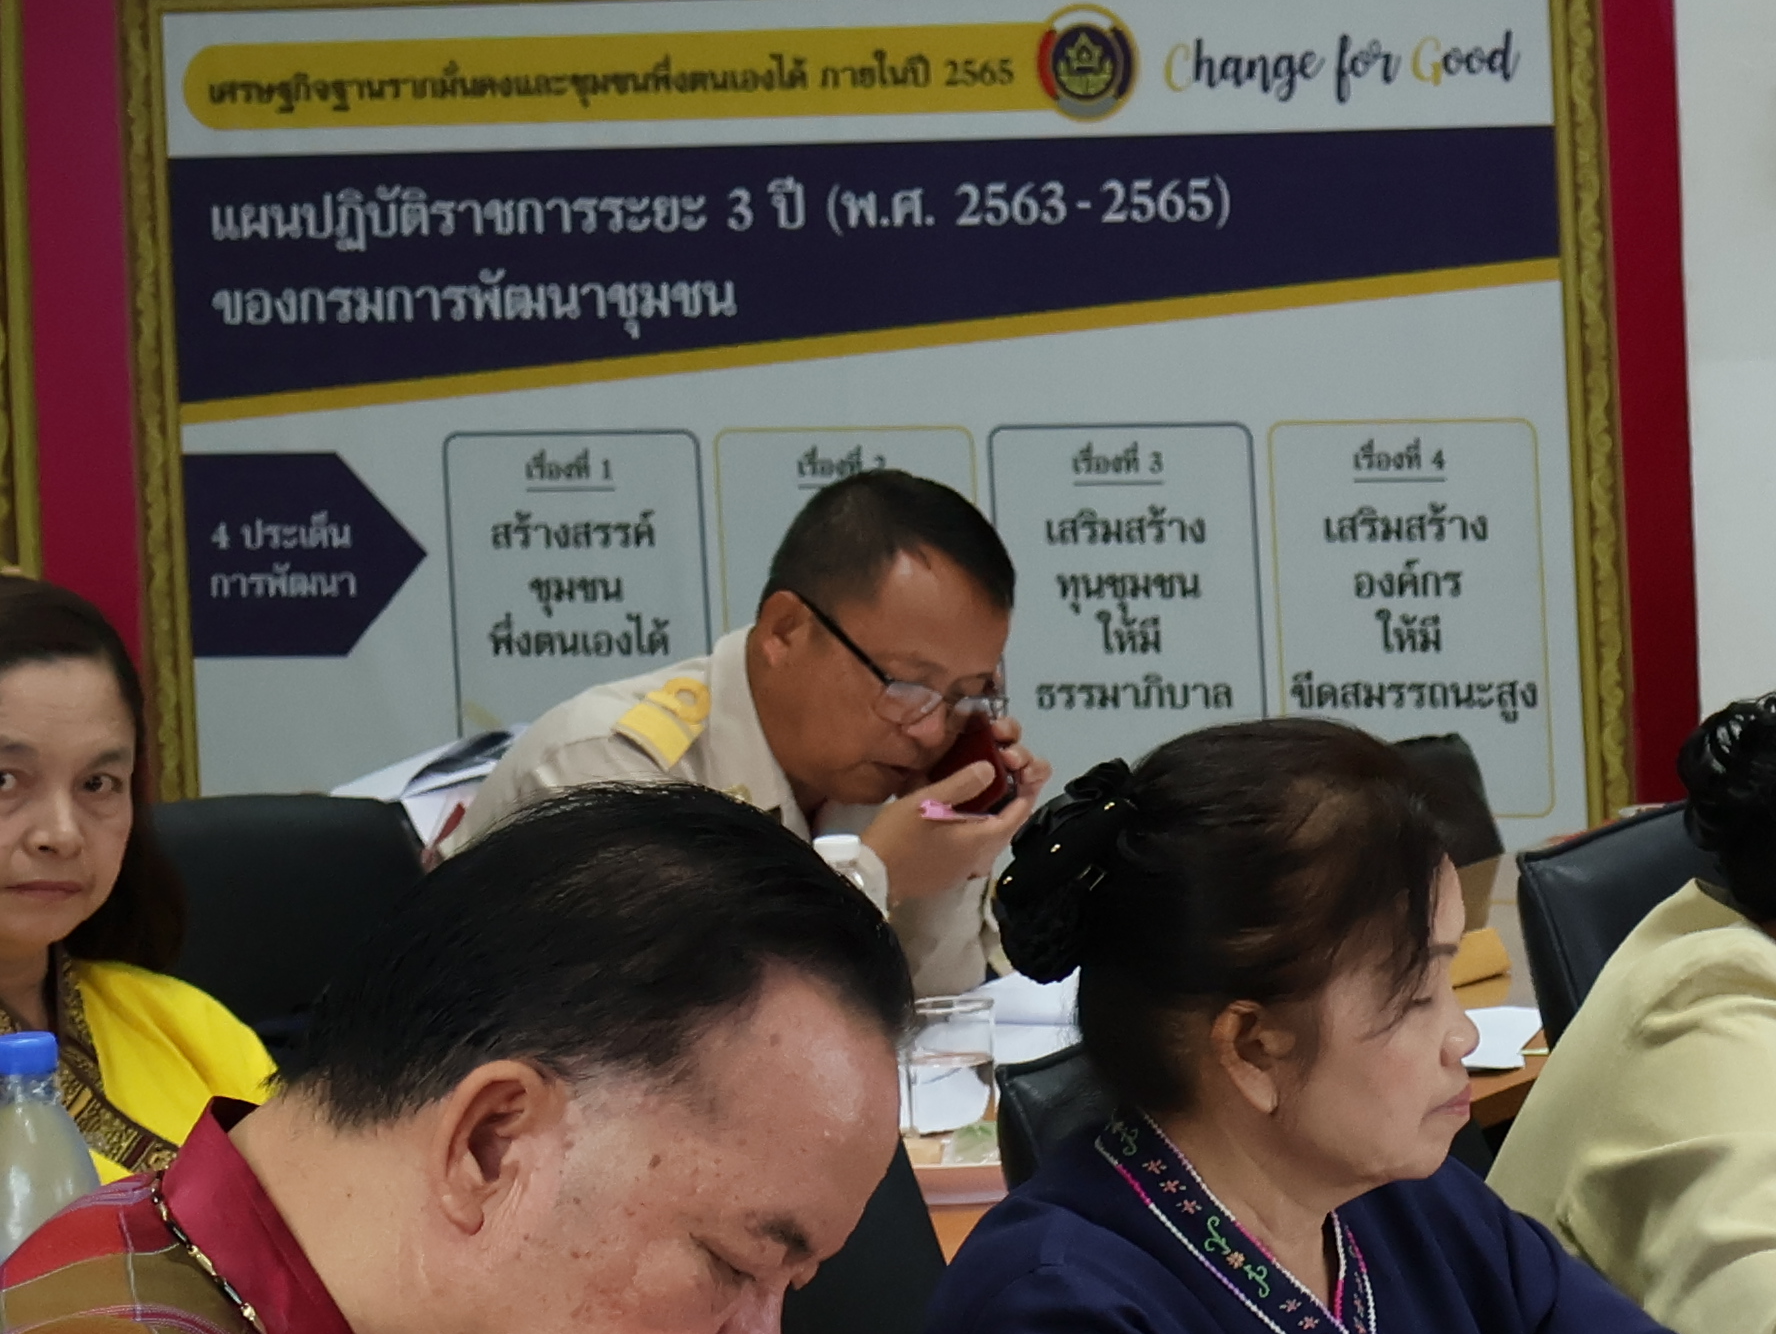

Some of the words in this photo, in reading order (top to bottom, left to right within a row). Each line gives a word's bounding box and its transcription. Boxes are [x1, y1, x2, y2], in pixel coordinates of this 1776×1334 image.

[945, 57, 1015, 88] 2565
[1164, 38, 1325, 102] Change
[1334, 33, 1401, 103] for
[1409, 30, 1521, 87] Good
[209, 183, 708, 252] แผนปฏิบัติราชการระยะ
[726, 190, 755, 233] 3
[766, 174, 805, 230] ปี
[825, 182, 935, 237] (พ.ศ.
[211, 269, 738, 339] ของกรมการพัฒนาชุมชน
[525, 448, 591, 482] เรื่องที่
[601, 458, 613, 481] 1
[1071, 441, 1140, 476] เรื่องที่
[1150, 450, 1164, 472] 3
[1353, 439, 1421, 473] เรื่องที่
[1430, 447, 1446, 469] 4
[211, 523, 230, 550] 4
[242, 511, 352, 551] ประเด็น
[491, 510, 655, 551] สร้างสรรค์
[1045, 504, 1206, 545] เสริมสร้าง
[1323, 503, 1488, 544] เสริมสร้าง
[210, 564, 358, 599] การพัฒนา
[529, 573, 622, 617] ชุมชน
[1056, 570, 1201, 614] ทุนชุมชน
[1354, 562, 1462, 599] องค์กร
[489, 614, 670, 658] พึ่งตนเองได้
[1096, 610, 1161, 654] ให้มี
[1376, 610, 1440, 652] ให้มี
[1035, 673, 1233, 711] ธรรมาภิบาล
[1291, 673, 1537, 722] ขีดสมรรถนะสูง
